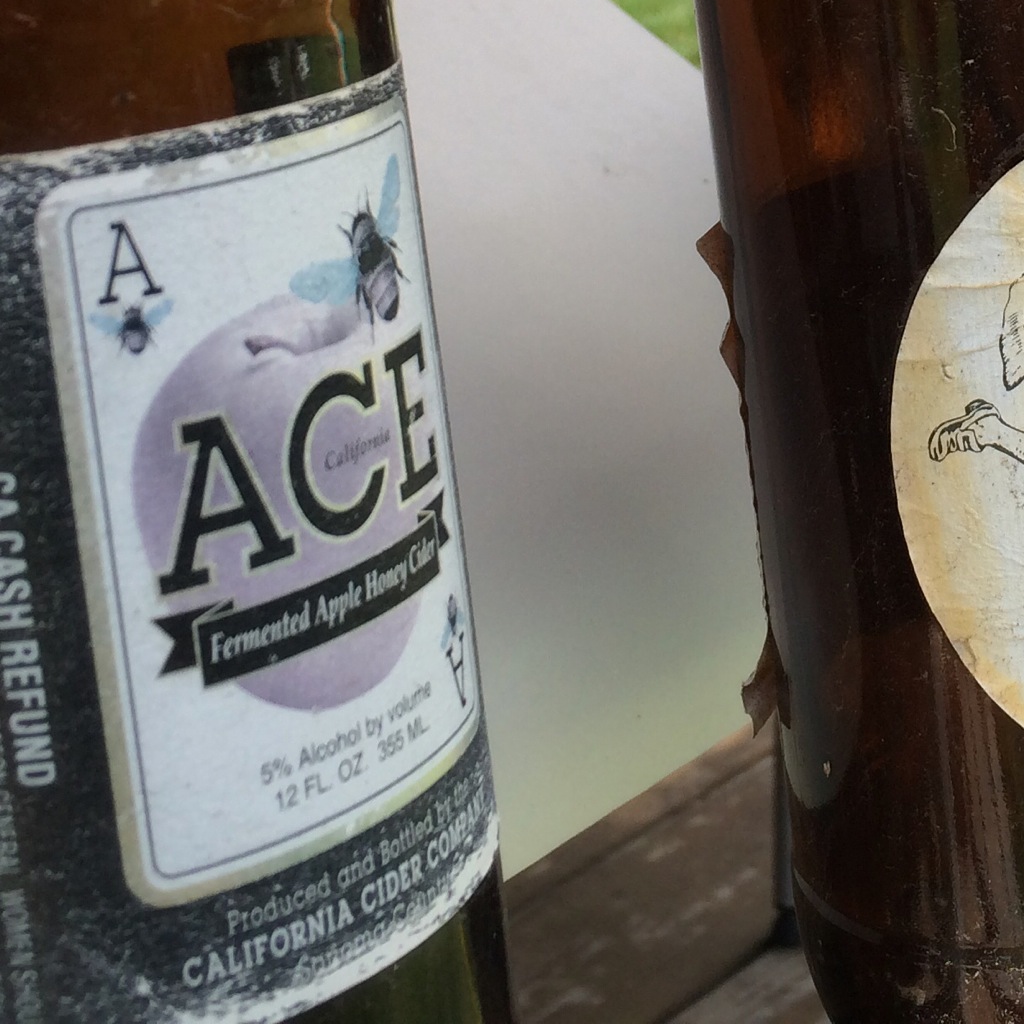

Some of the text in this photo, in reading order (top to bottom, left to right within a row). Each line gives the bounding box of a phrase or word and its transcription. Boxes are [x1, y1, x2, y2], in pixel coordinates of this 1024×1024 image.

[97, 219, 164, 305] A
[156, 328, 441, 596] ACE
[322, 426, 392, 473] California
[209, 535, 437, 665] Fermented Apple Honey Cider
[0, 638, 58, 788] REFUND
[260, 680, 432, 787] 5% Alcohol by volume
[276, 783, 299, 812] 12
[377, 728, 405, 763] 355
[181, 896, 355, 989] CALIFORNIA
[359, 852, 423, 914] CIDER
[227, 872, 333, 936] Produced
[336, 851, 376, 889] and
[377, 805, 433, 867] Bottled
